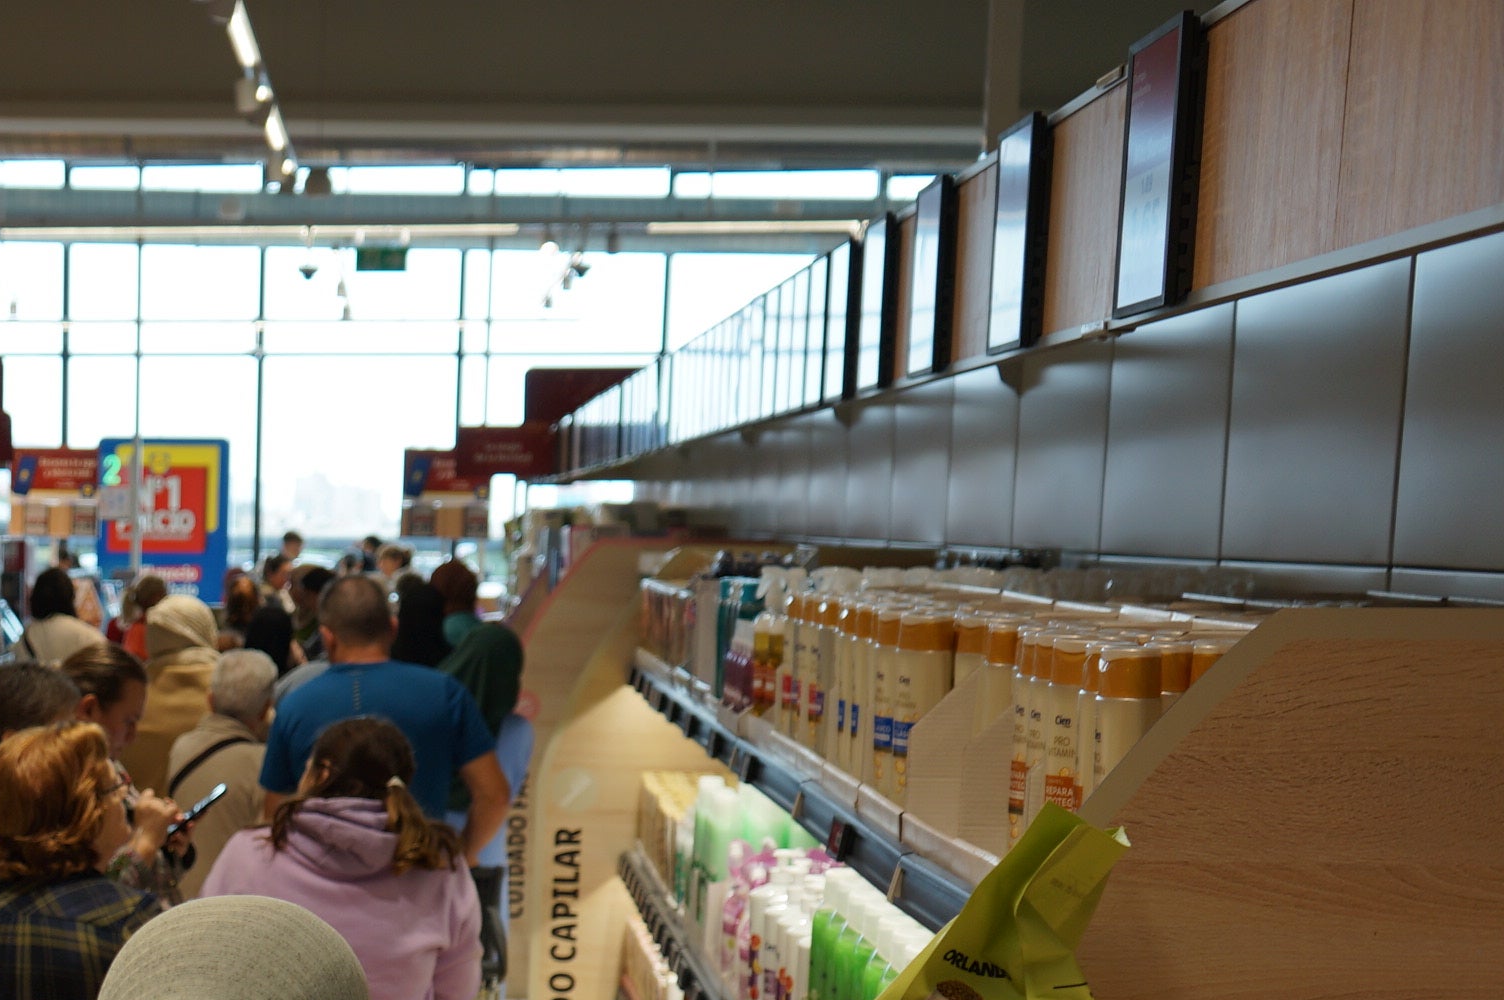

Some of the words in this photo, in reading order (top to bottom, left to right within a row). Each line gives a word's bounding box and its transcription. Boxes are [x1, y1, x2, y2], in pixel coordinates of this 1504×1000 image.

[102, 453, 121, 486] 2
[1055, 715, 1071, 728] Cien
[1053, 736, 1070, 747] PRO
[507, 815, 528, 919] CUIDADO
[550, 827, 583, 962] CAPILAR
